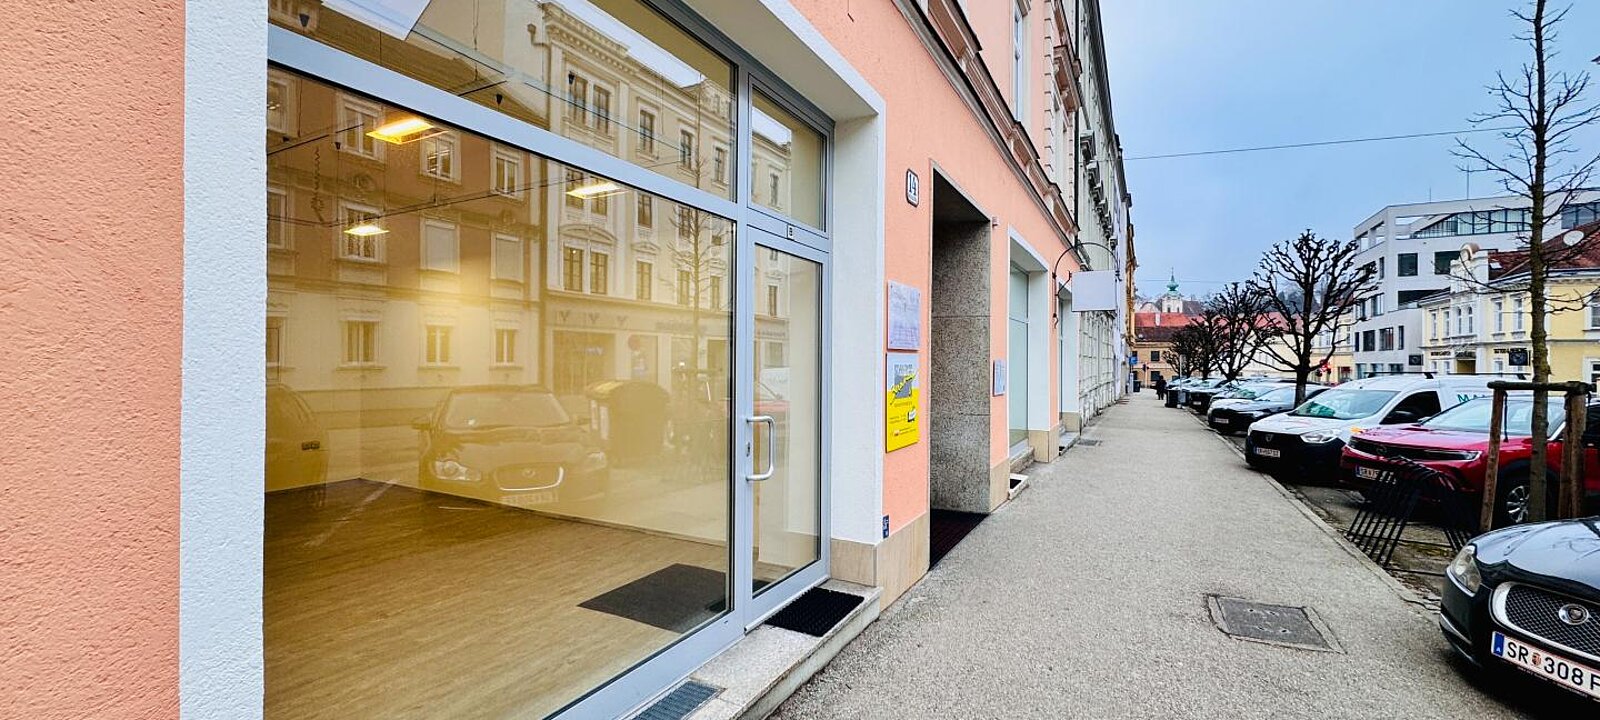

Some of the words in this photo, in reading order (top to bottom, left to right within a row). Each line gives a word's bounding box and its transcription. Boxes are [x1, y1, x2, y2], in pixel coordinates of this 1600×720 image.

[909, 173, 917, 196] 14
[1507, 642, 1529, 664] SR
[1544, 657, 1584, 686] 308
